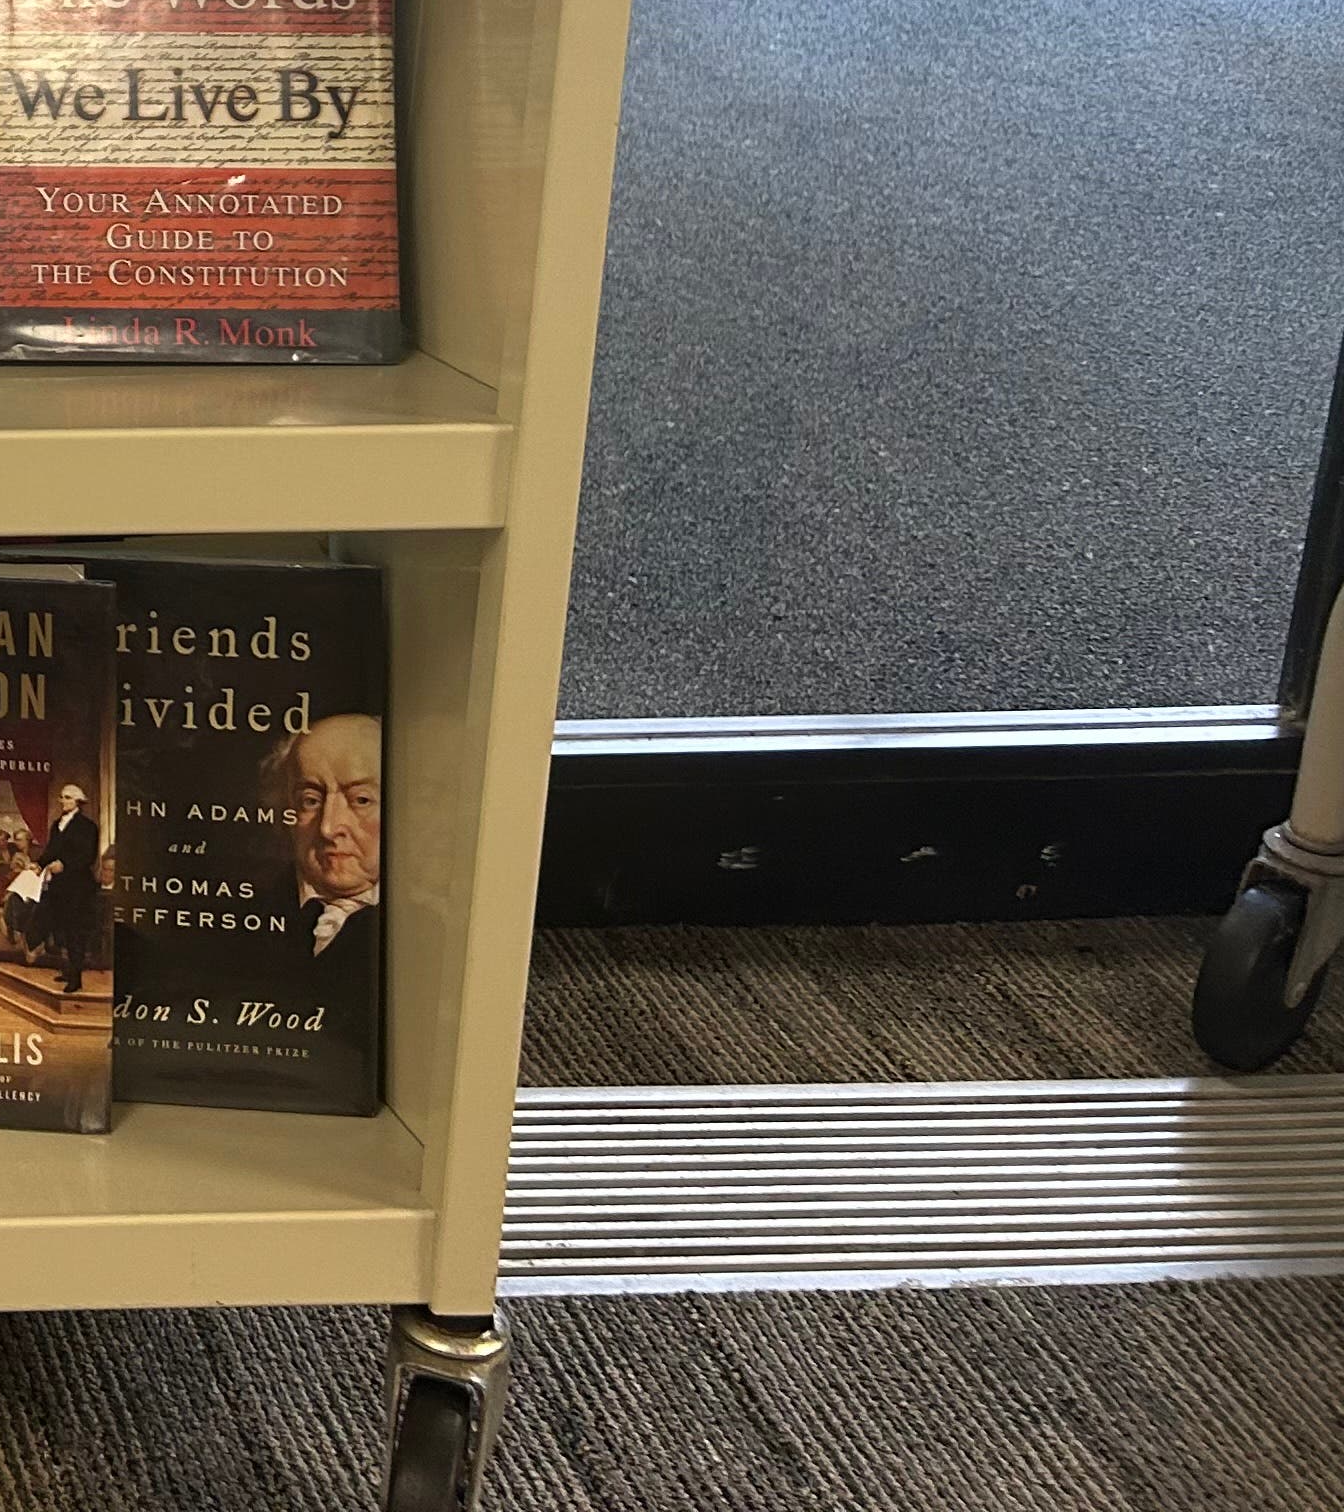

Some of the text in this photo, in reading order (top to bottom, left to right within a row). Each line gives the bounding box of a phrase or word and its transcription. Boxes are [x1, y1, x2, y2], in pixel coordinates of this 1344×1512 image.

[6, 66, 361, 139] We Live By
[34, 187, 343, 216] YOUR ANNOTATED
[105, 222, 274, 251] GUIDE TO
[31, 258, 349, 288] THE CONSTITUTION
[187, 803, 299, 825] ADAMS
[169, 841, 207, 856] and
[120, 875, 255, 899] THOMAS
